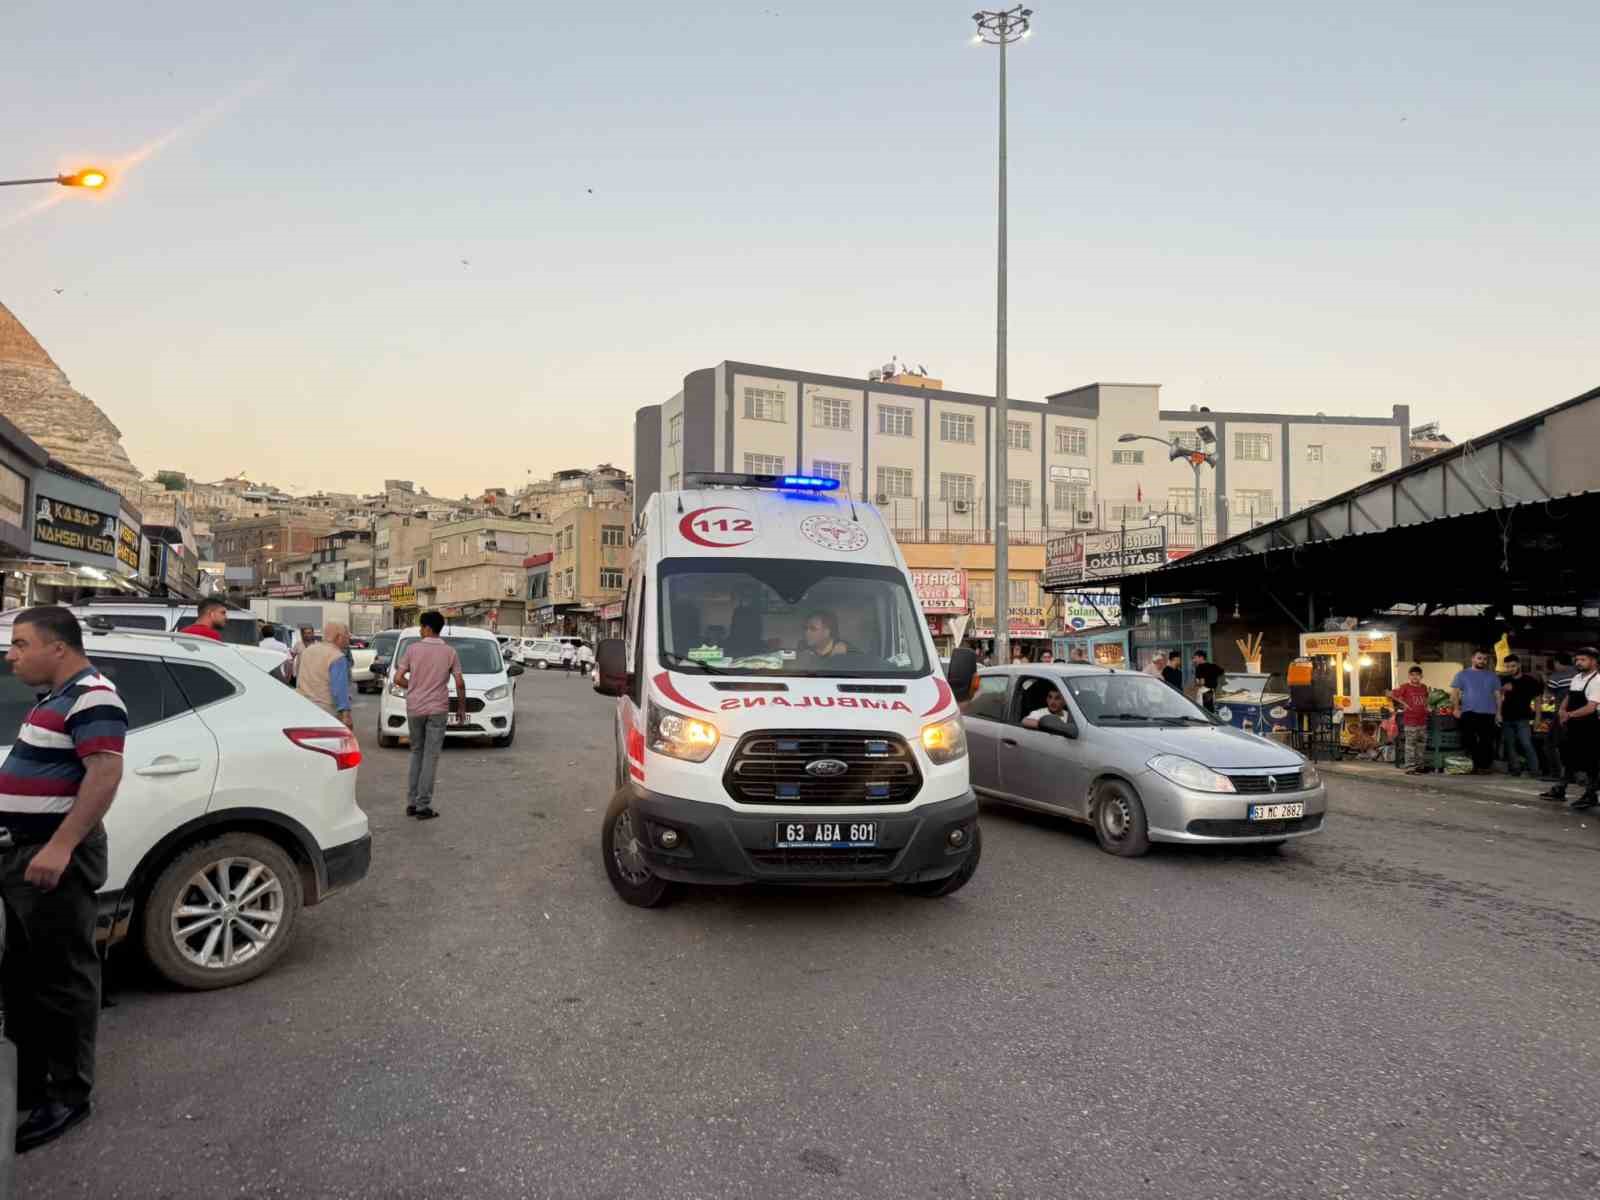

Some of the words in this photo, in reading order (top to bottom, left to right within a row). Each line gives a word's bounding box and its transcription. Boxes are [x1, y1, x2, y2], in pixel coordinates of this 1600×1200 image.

[54, 504, 98, 525] KASAP
[693, 519, 753, 533] 112
[87, 538, 113, 551] USTA
[786, 824, 805, 841] 63
[815, 824, 841, 841] ABA
[850, 823, 874, 841] 601
